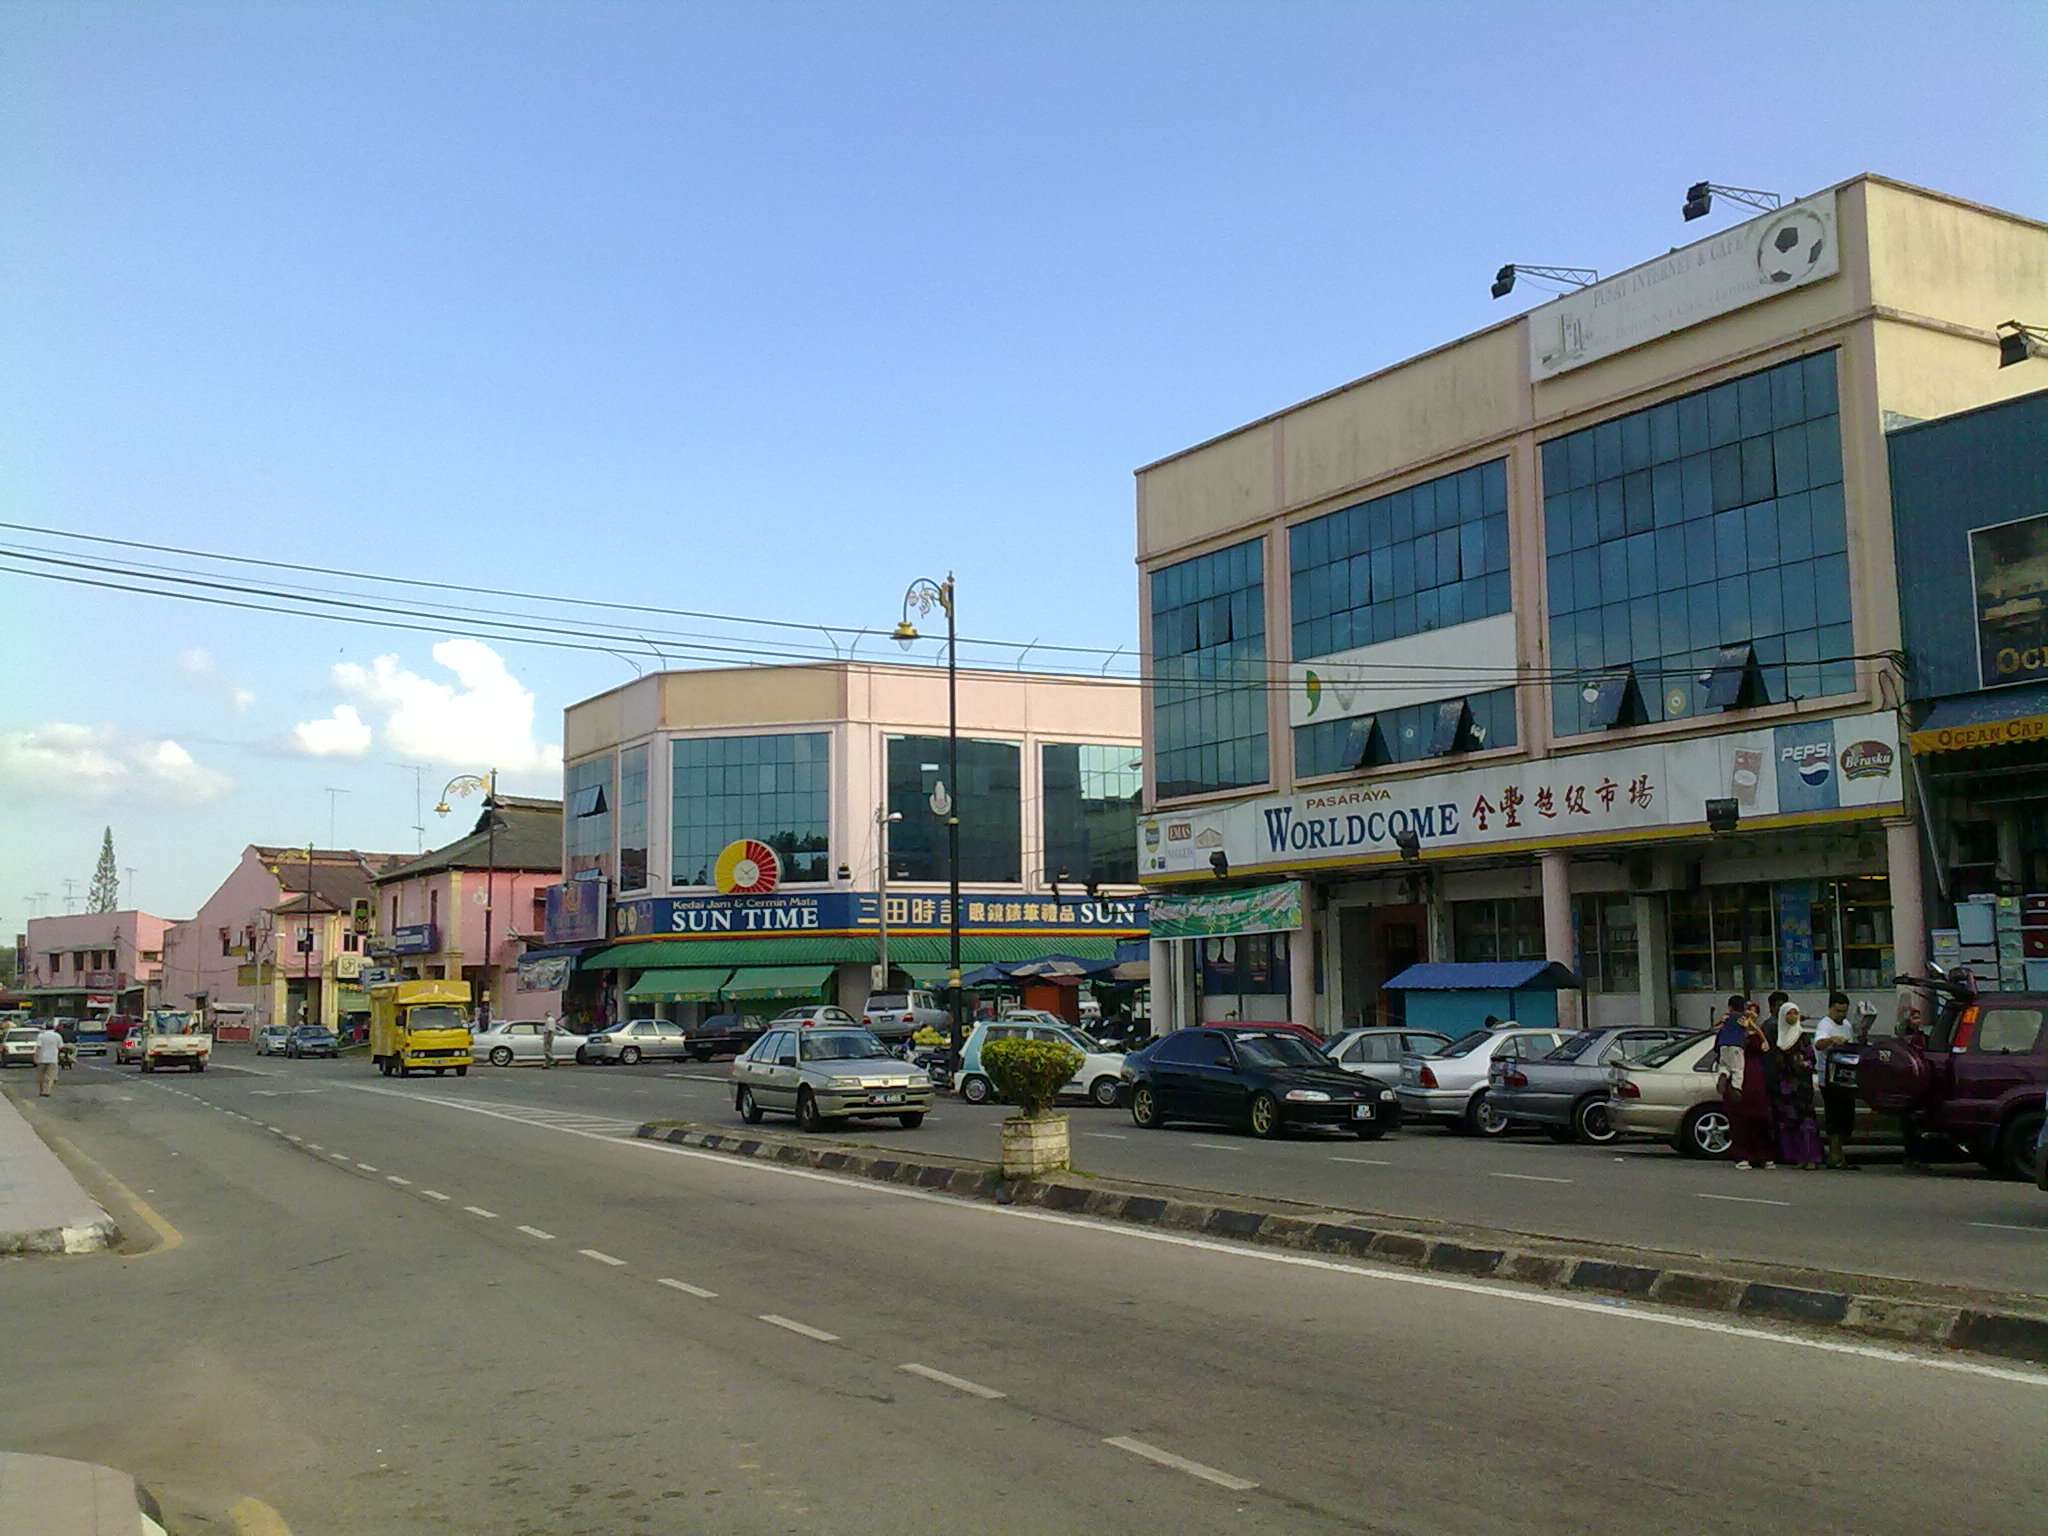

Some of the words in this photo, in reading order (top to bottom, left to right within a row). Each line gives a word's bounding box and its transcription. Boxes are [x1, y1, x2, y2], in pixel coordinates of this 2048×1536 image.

[1938, 727, 2000, 746] OCEAN
[1780, 742, 1832, 762] PEPSI
[1306, 789, 1392, 809] PASARAYA
[672, 900, 704, 910] Kedai
[706, 900, 731, 909] Jam
[733, 899, 744, 908] &
[745, 898, 787, 908] Cermin
[789, 897, 818, 906] Mata
[1080, 902, 1137, 924] SUN
[672, 909, 733, 932] SUN
[741, 907, 819, 930] TIME
